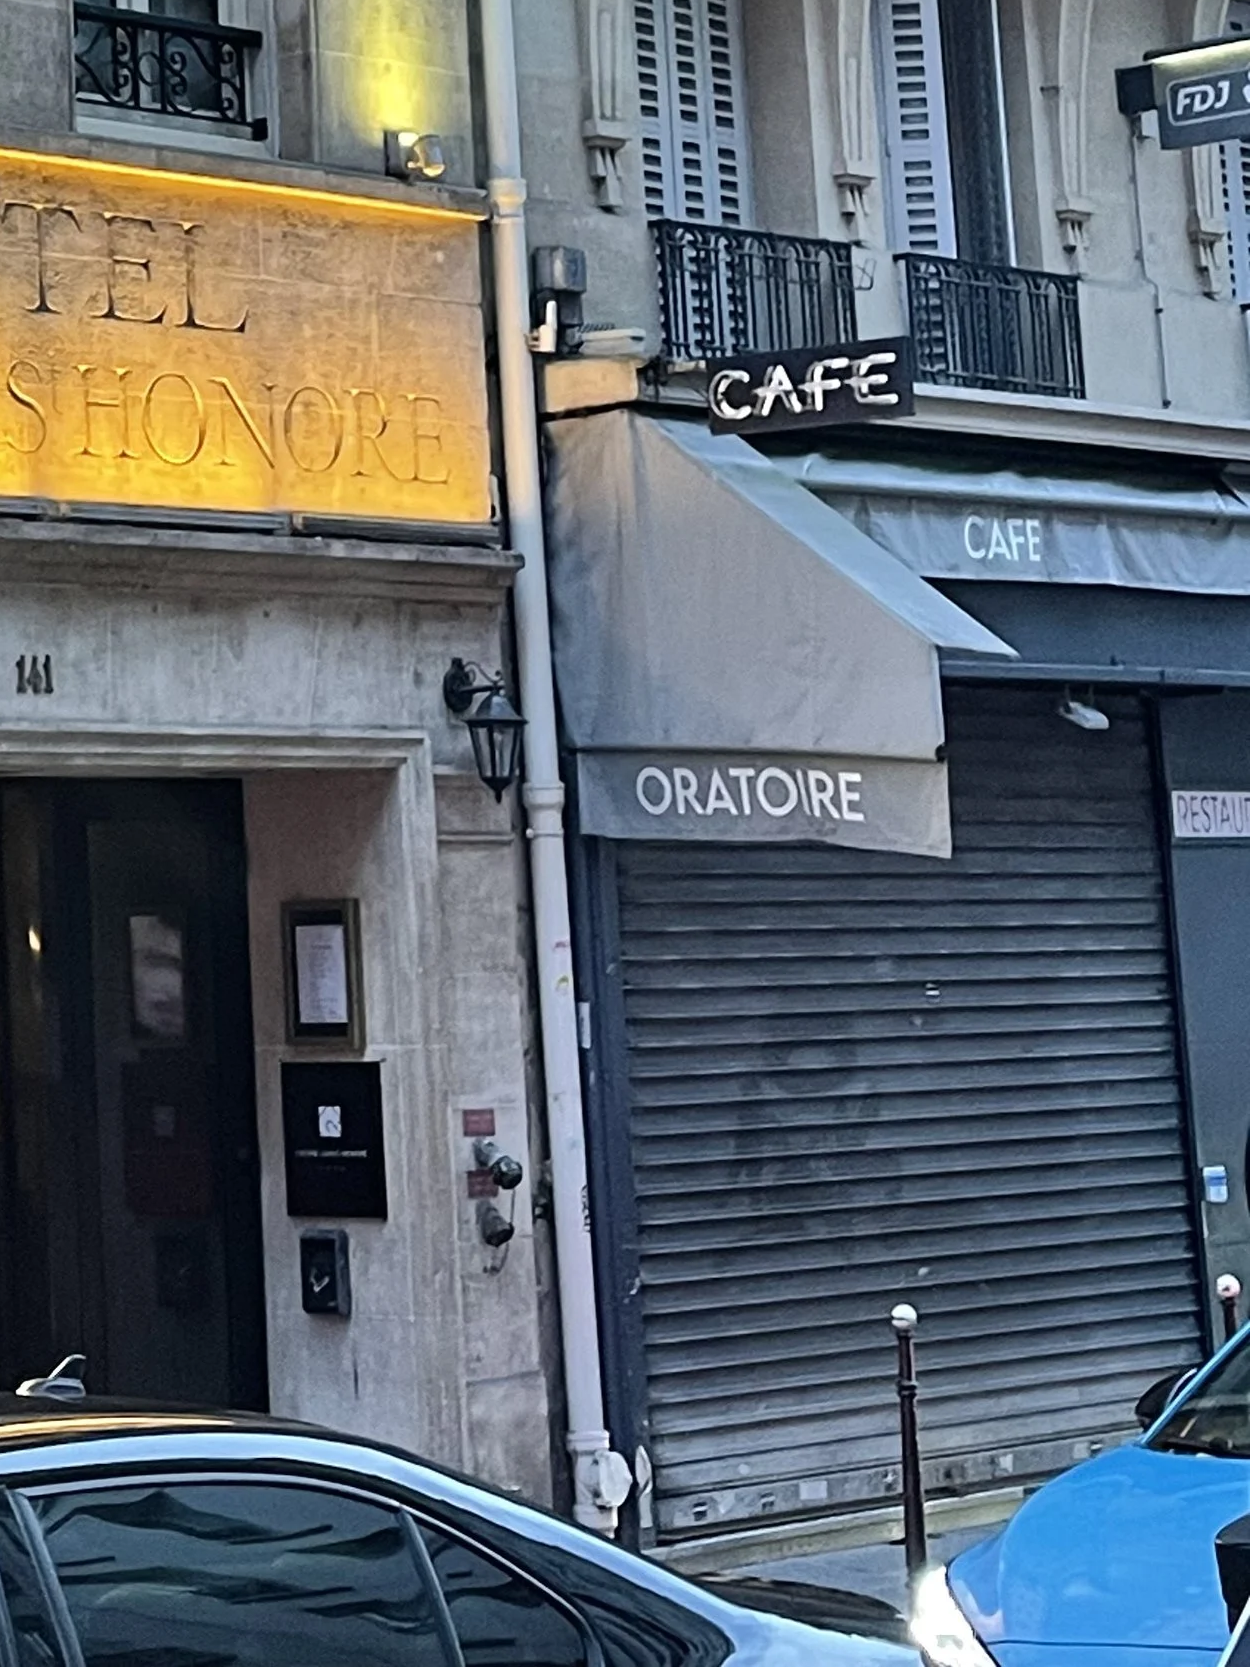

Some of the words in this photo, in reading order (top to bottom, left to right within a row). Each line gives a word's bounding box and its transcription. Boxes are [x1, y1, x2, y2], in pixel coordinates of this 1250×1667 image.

[1176, 80, 1230, 116] FDJ
[708, 351, 899, 421] CAFE
[72, 363, 451, 486] HONORE
[963, 514, 1041, 563] CAFE
[635, 765, 866, 823] ORATOIRE
